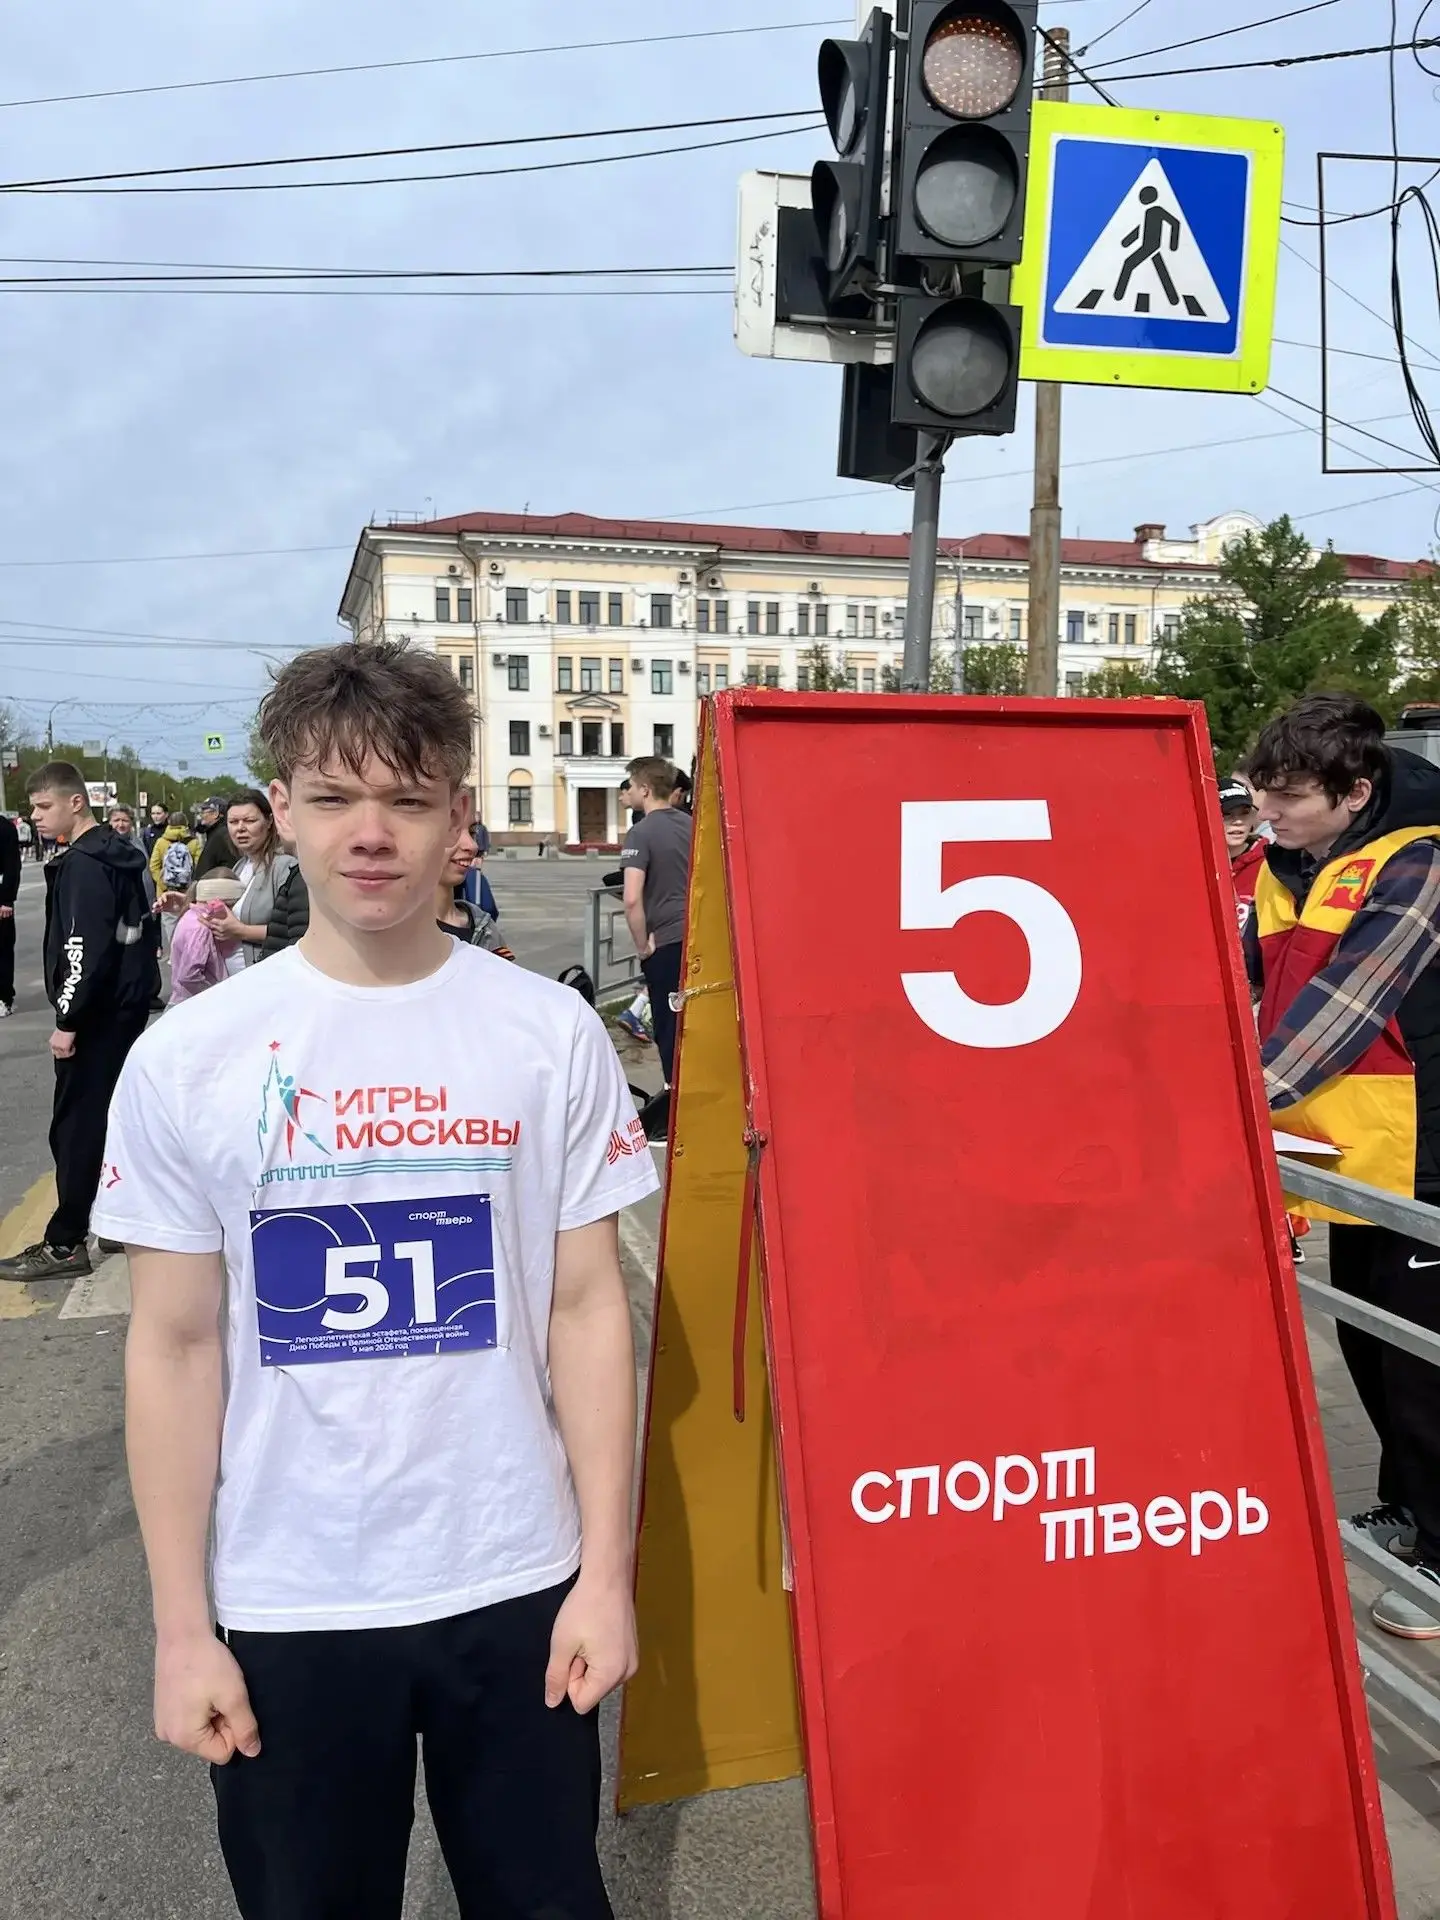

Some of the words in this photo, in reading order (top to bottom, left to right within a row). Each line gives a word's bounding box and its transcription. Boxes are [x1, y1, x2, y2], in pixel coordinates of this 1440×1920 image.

[900, 799, 1083, 1049] 5
[57, 936, 83, 1015] swoosh
[335, 1086, 447, 1116] ИГРЫ
[336, 1119, 521, 1150] МОСКВЫ
[408, 1210, 447, 1221] спорт
[435, 1216, 473, 1226] тверь
[321, 1240, 437, 1331] 51
[288, 1344, 308, 1352] Дню
[308, 1341, 341, 1350] Победы
[348, 1337, 383, 1347] Великой
[383, 1333, 445, 1344] Отечественной
[445, 1330, 470, 1338] войне
[295, 1331, 371, 1344] Легкоатлетическая
[371, 1328, 409, 1338] эстафета,
[351, 1346, 358, 1354] 9
[374, 1343, 395, 1352] 2026
[394, 1342, 410, 1350] год
[849, 1446, 1096, 1524] спорт
[1039, 1486, 1270, 1563] тверь
